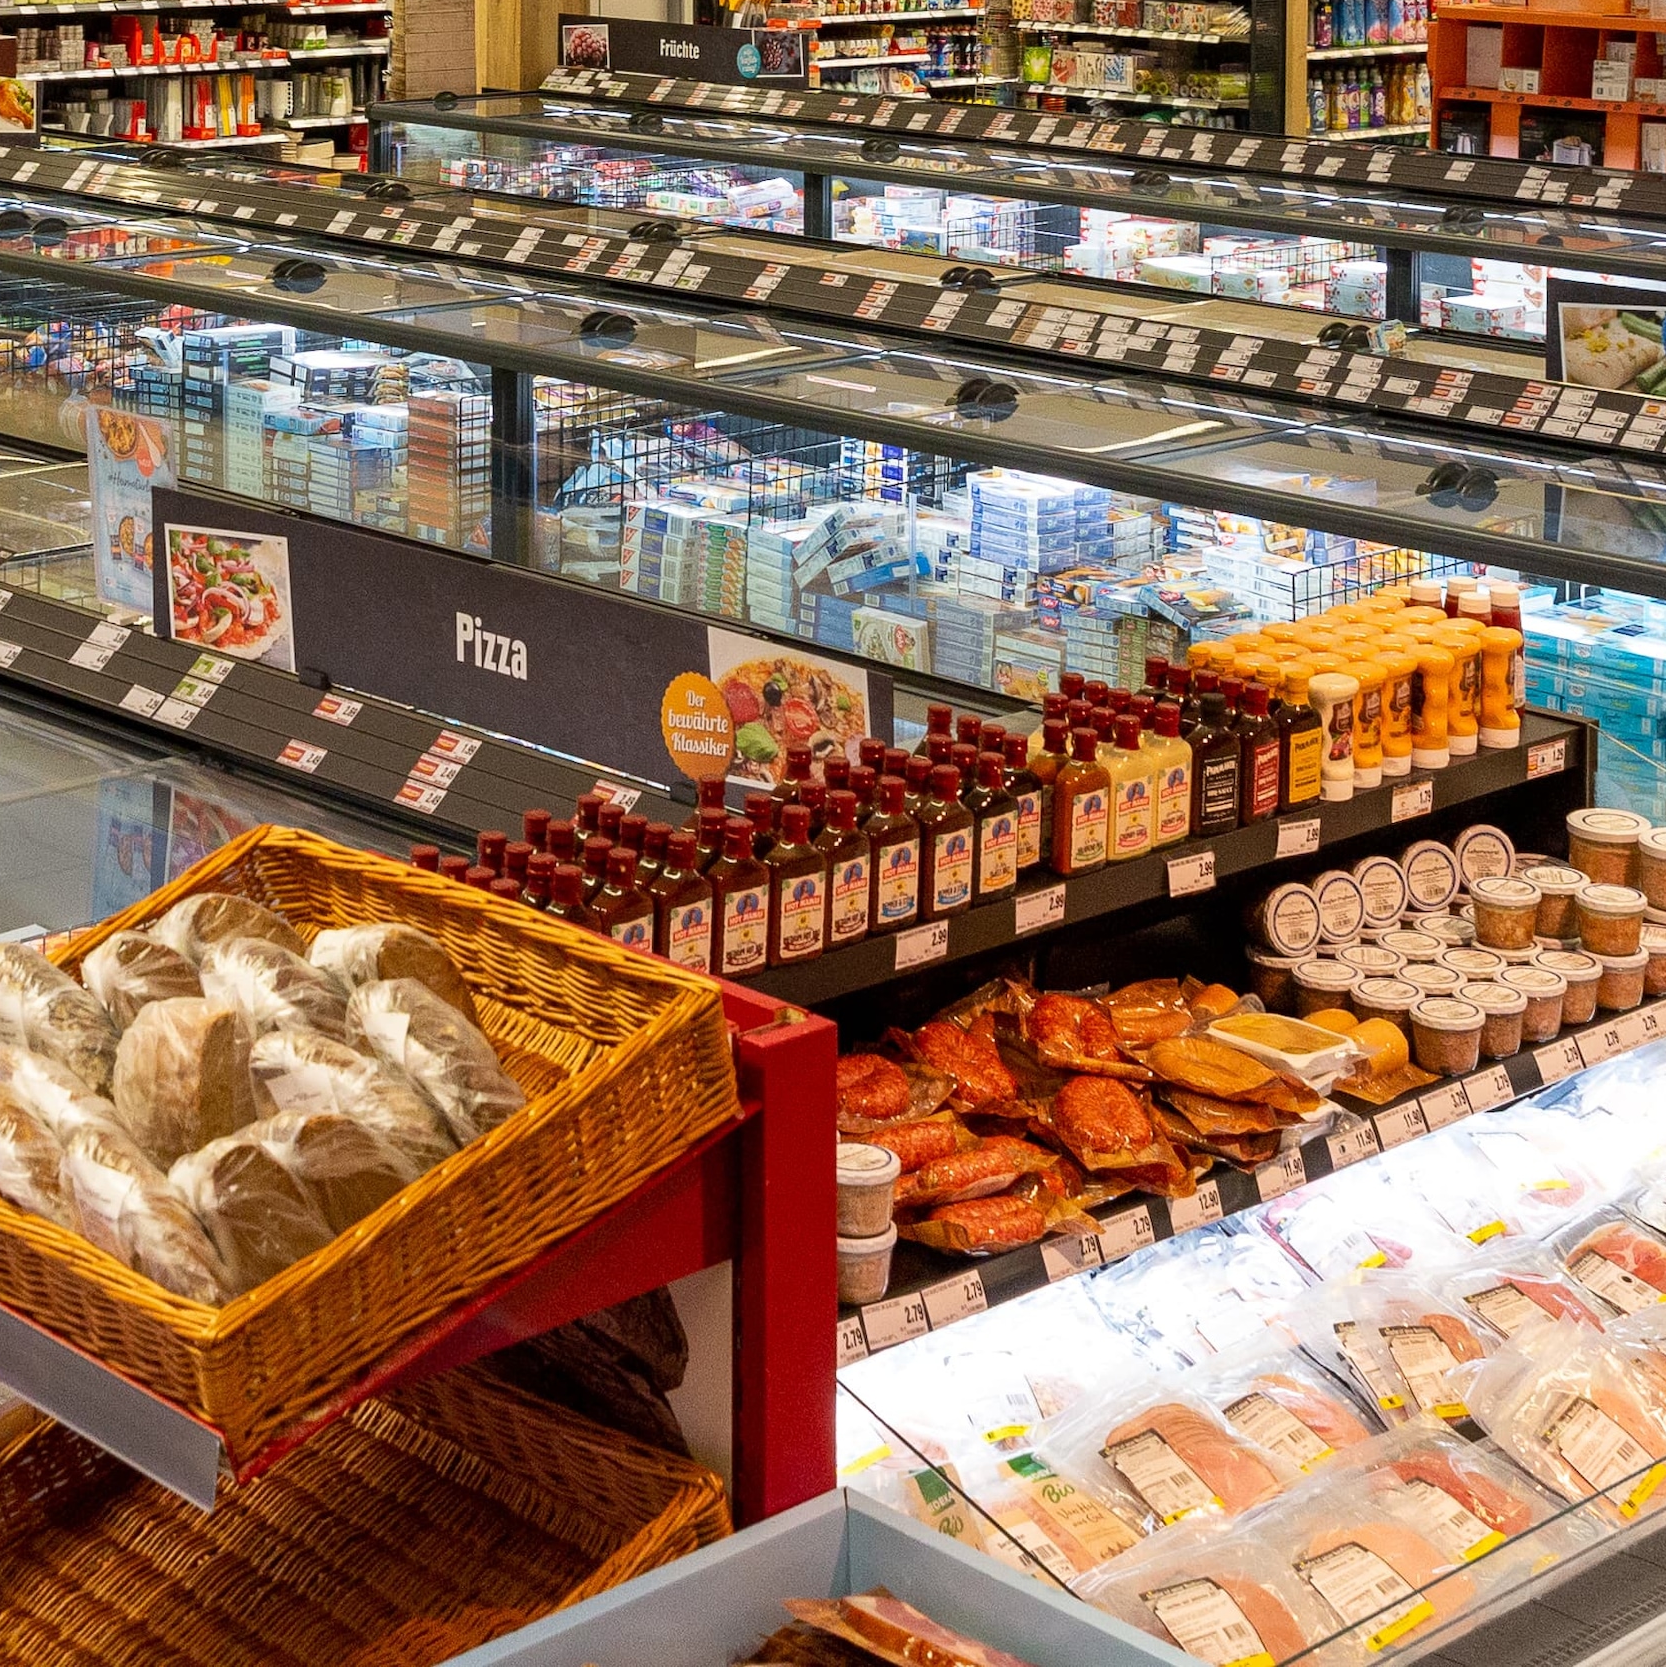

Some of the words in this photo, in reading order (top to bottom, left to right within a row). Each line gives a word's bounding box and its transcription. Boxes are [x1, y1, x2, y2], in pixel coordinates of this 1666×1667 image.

[660, 38, 700, 60] Früchte
[456, 611, 528, 682] Pizza
[686, 690, 705, 708] Der
[668, 708, 728, 734] bewährte
[672, 732, 729, 758] Klassiker
[1419, 790, 1432, 805] 1.79
[1306, 828, 1319, 842] 2.99
[1199, 861, 1214, 877] 2.99
[1049, 895, 1064, 911] 2.99
[932, 929, 946, 947] 2.99
[1642, 1014, 1657, 1031] 2.79
[1605, 1030, 1620, 1047] 2.79
[1564, 1047, 1579, 1063] 2.79
[1494, 1073, 1512, 1093] 2.79
[1449, 1090, 1467, 1110] 3.79
[1403, 1108, 1423, 1130] 11.90
[1355, 1127, 1376, 1149] 11.90
[1282, 1157, 1303, 1180] 11.90
[1198, 1189, 1221, 1212] 12.90
[1132, 1216, 1152, 1236] 2.79
[1078, 1235, 1097, 1256] 2.79
[964, 1279, 985, 1301] 2.79
[904, 1302, 925, 1325] 2.79
[844, 1328, 864, 1350] 2.79
[1041, 1483, 1075, 1504] Bio
